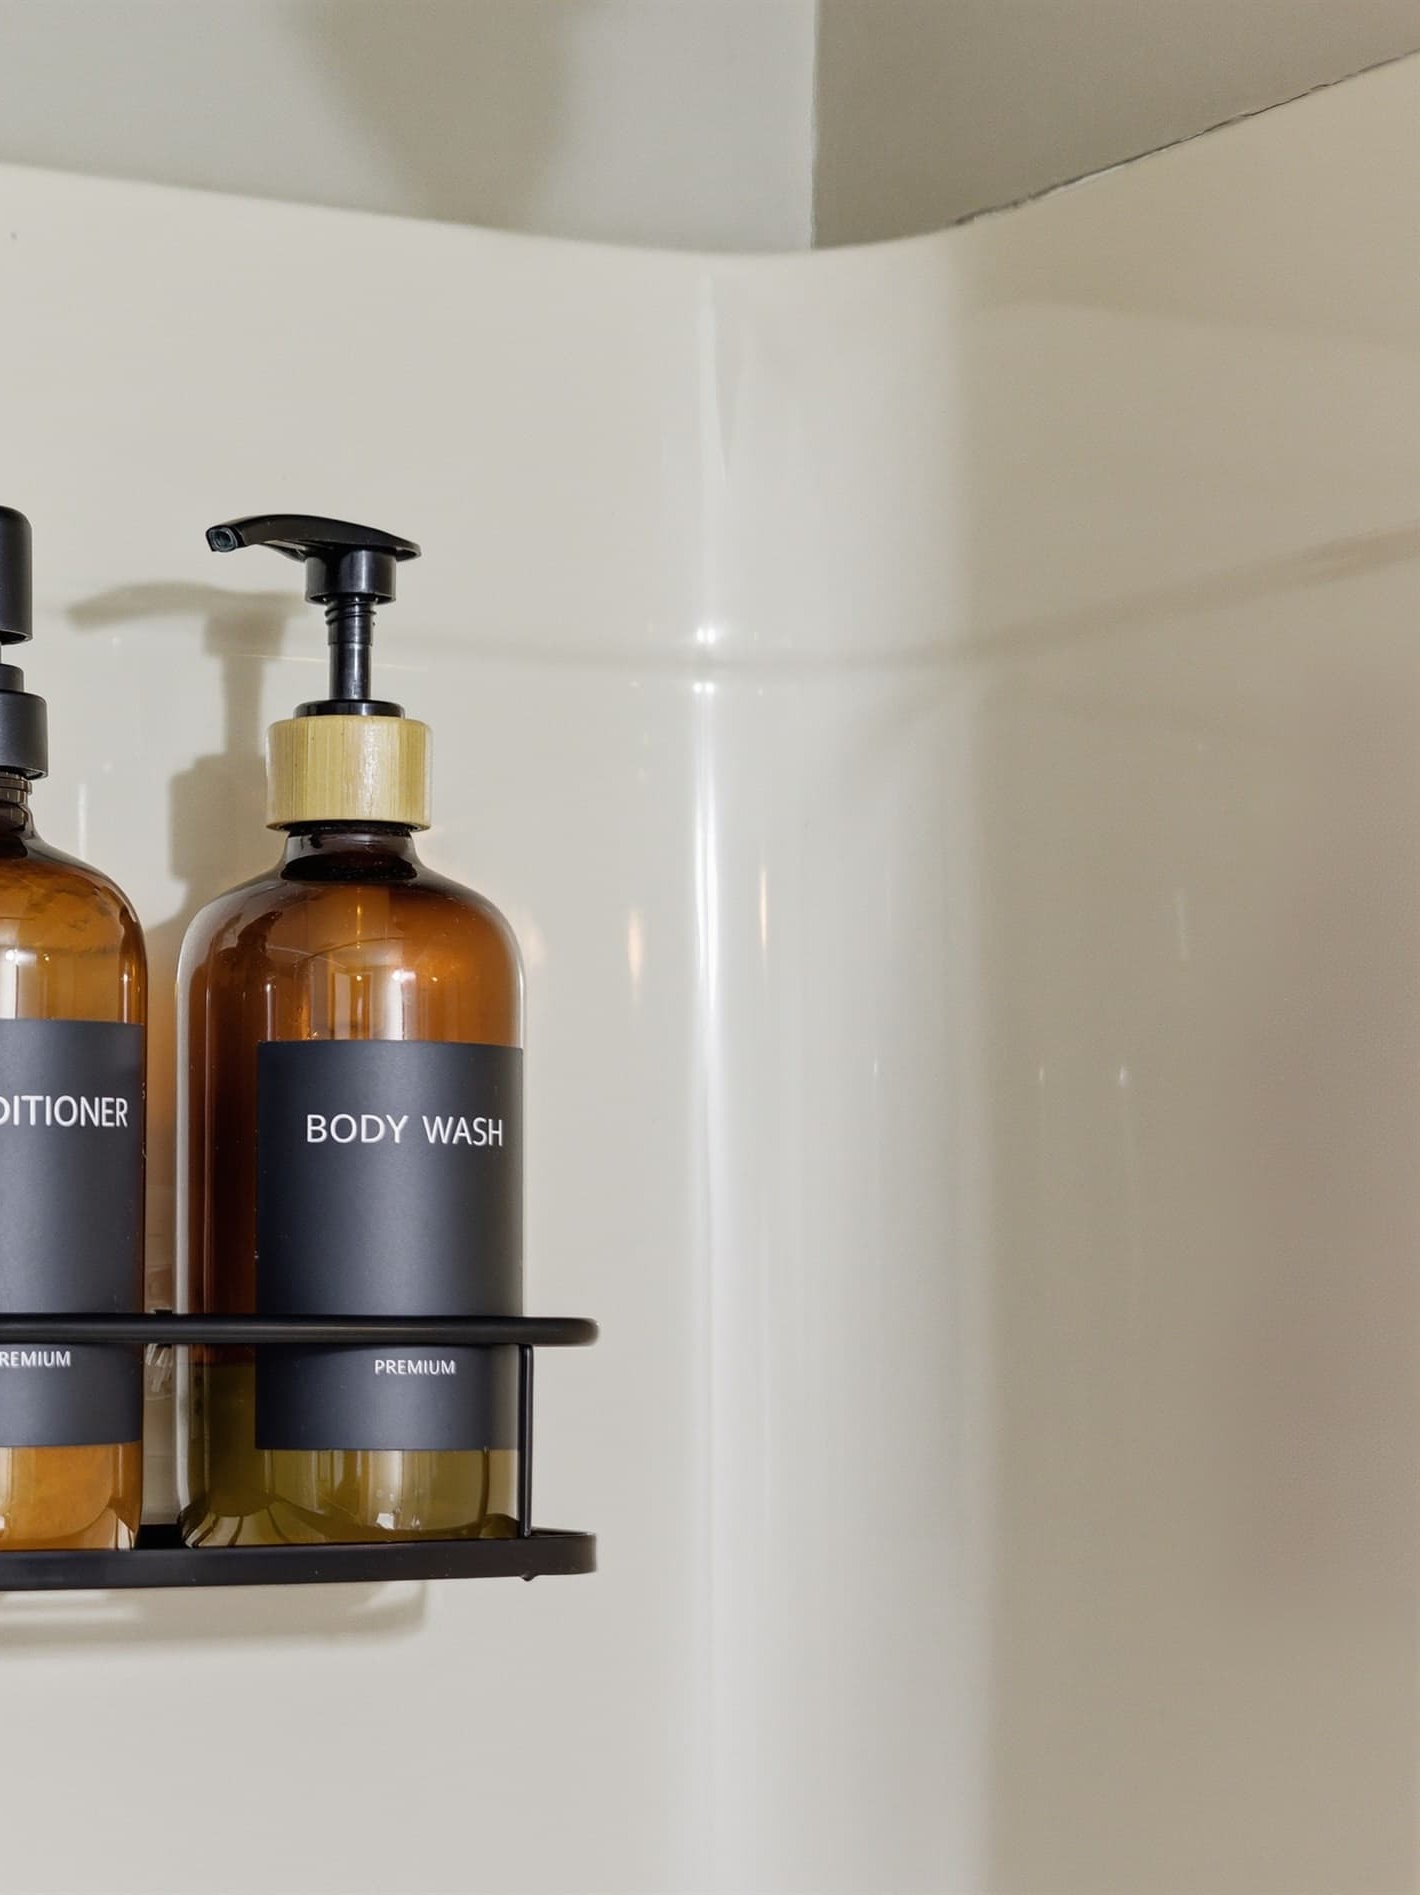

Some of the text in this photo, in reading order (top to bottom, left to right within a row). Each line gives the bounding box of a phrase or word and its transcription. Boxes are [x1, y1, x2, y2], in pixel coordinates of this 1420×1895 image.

[306, 1113, 504, 1147] BODY WASH
[373, 1358, 456, 1376] PREMIUM
